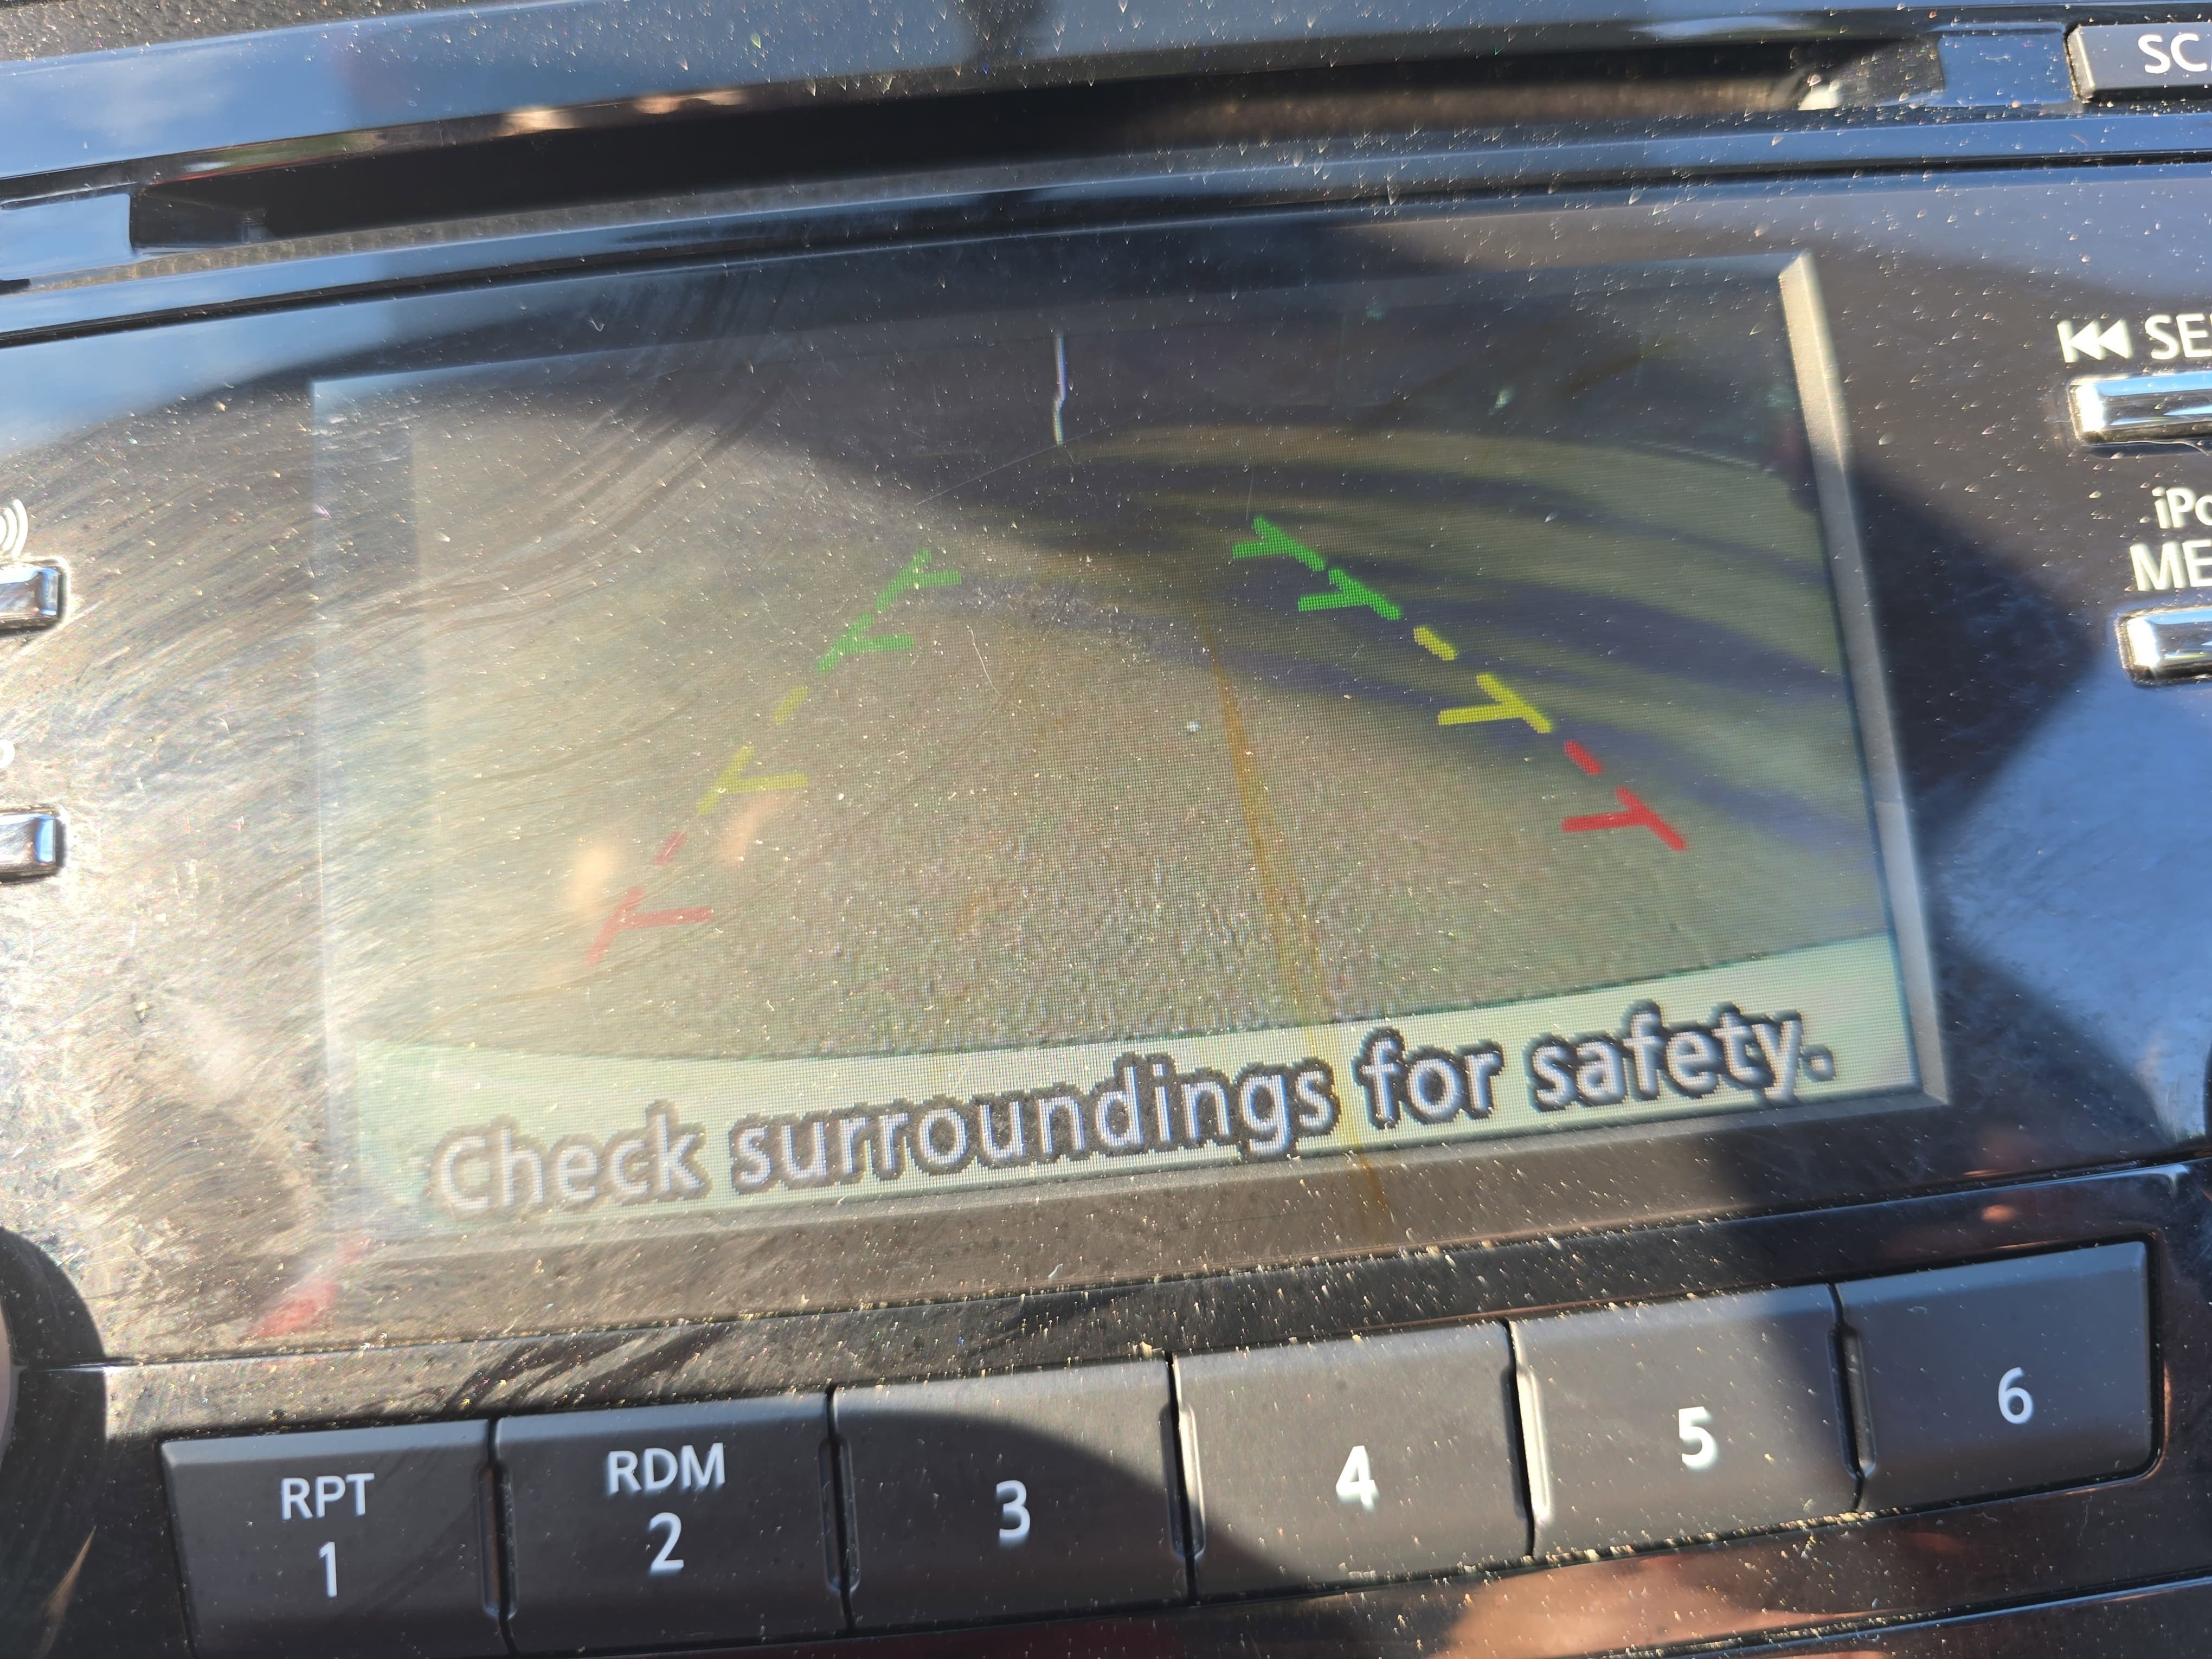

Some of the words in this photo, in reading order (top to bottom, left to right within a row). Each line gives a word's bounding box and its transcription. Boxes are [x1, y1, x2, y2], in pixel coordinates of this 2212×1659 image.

[2138, 32, 2212, 74] SC
[2144, 313, 2212, 360] SE
[436, 1104, 706, 1214] Check
[730, 1056, 1338, 1192] surroundings
[1356, 1031, 1502, 1128] for
[1528, 1003, 1831, 1109] safety.
[1997, 1366, 2034, 1425] 6
[1678, 1405, 1718, 1470] 5
[281, 1472, 375, 1520] RPT
[607, 1442, 725, 1495] RDM
[1335, 1444, 1378, 1509] 4
[996, 1480, 1031, 1545] 3
[318, 1541, 338, 1598] 1
[650, 1512, 685, 1573] 2
